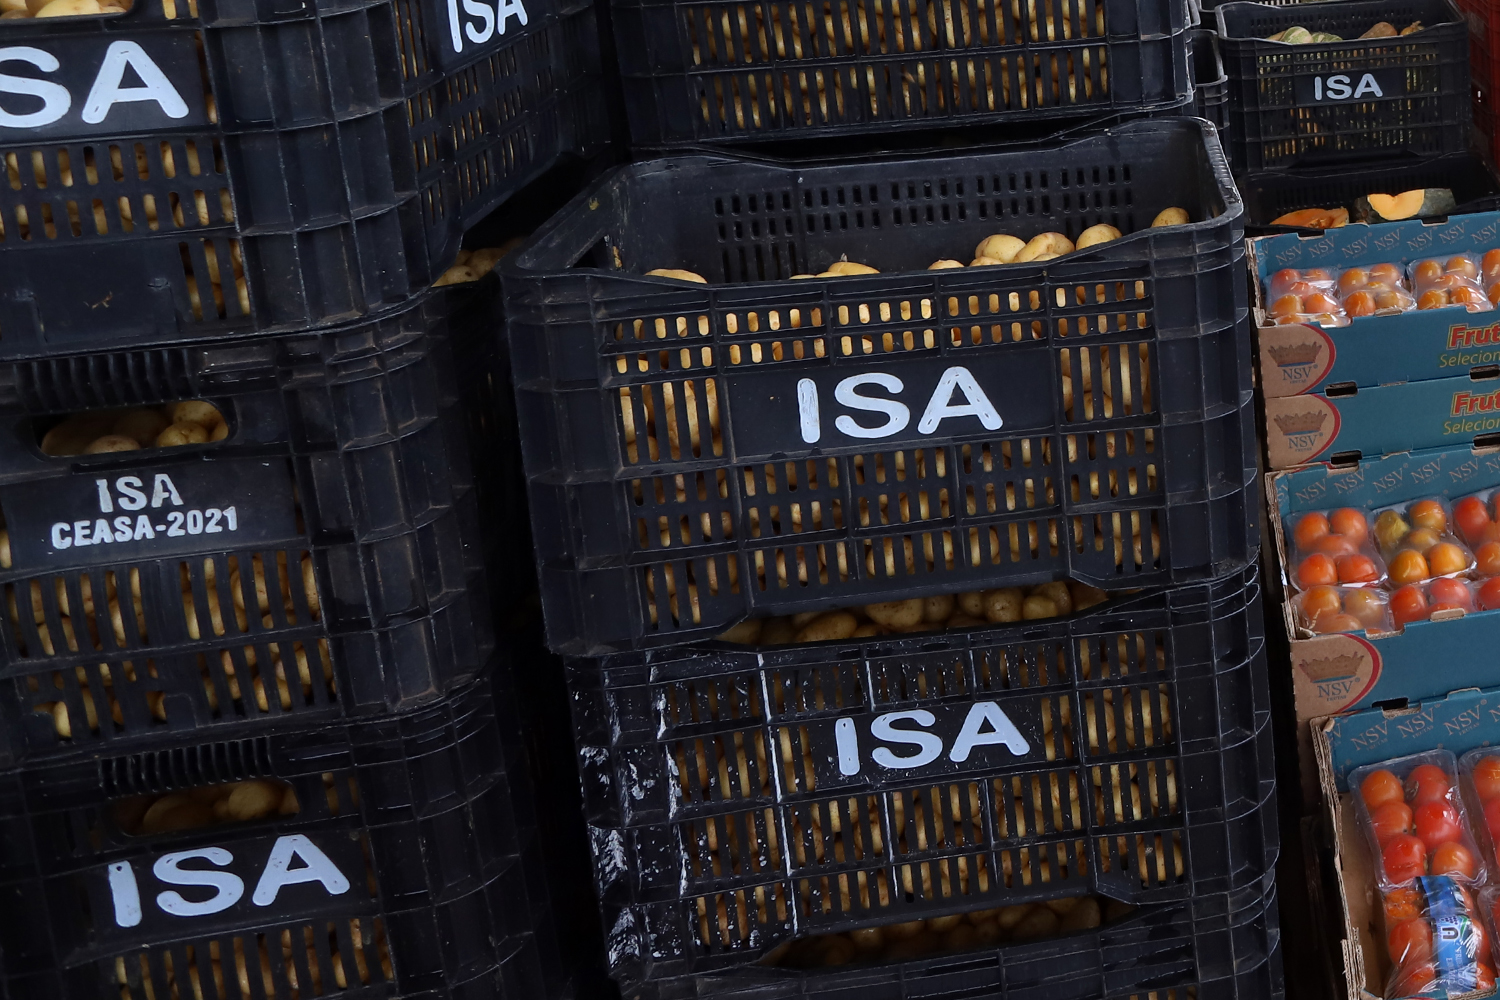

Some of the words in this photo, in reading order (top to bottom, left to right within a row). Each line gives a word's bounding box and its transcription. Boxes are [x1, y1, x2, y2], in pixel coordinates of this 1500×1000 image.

[0, 39, 189, 128] SA
[1314, 73, 1383, 100] ISA
[1374, 229, 1400, 251] NSV
[1407, 231, 1433, 250] NSV
[1439, 225, 1466, 244] NSV
[1471, 224, 1498, 244] NSV
[1276, 246, 1300, 266] NSV
[1308, 236, 1334, 258] NSV
[1342, 237, 1368, 259] NSV
[1282, 366, 1312, 381] NSV
[796, 366, 1004, 443] ISA
[1288, 434, 1318, 449] NSV
[1334, 470, 1365, 494] NSV
[1373, 469, 1403, 494] NSV
[1411, 458, 1442, 484] NSV
[1449, 458, 1479, 483] NSV
[96, 473, 184, 514] ISA
[1295, 478, 1326, 504] NSV
[50, 505, 239, 550] CEASA-2021
[1317, 680, 1353, 698] NSV
[1397, 708, 1435, 738] NSV
[1443, 705, 1481, 735] NSV
[834, 700, 1030, 776] ISA
[1352, 722, 1388, 750] NSV
[107, 833, 350, 928] ISA
